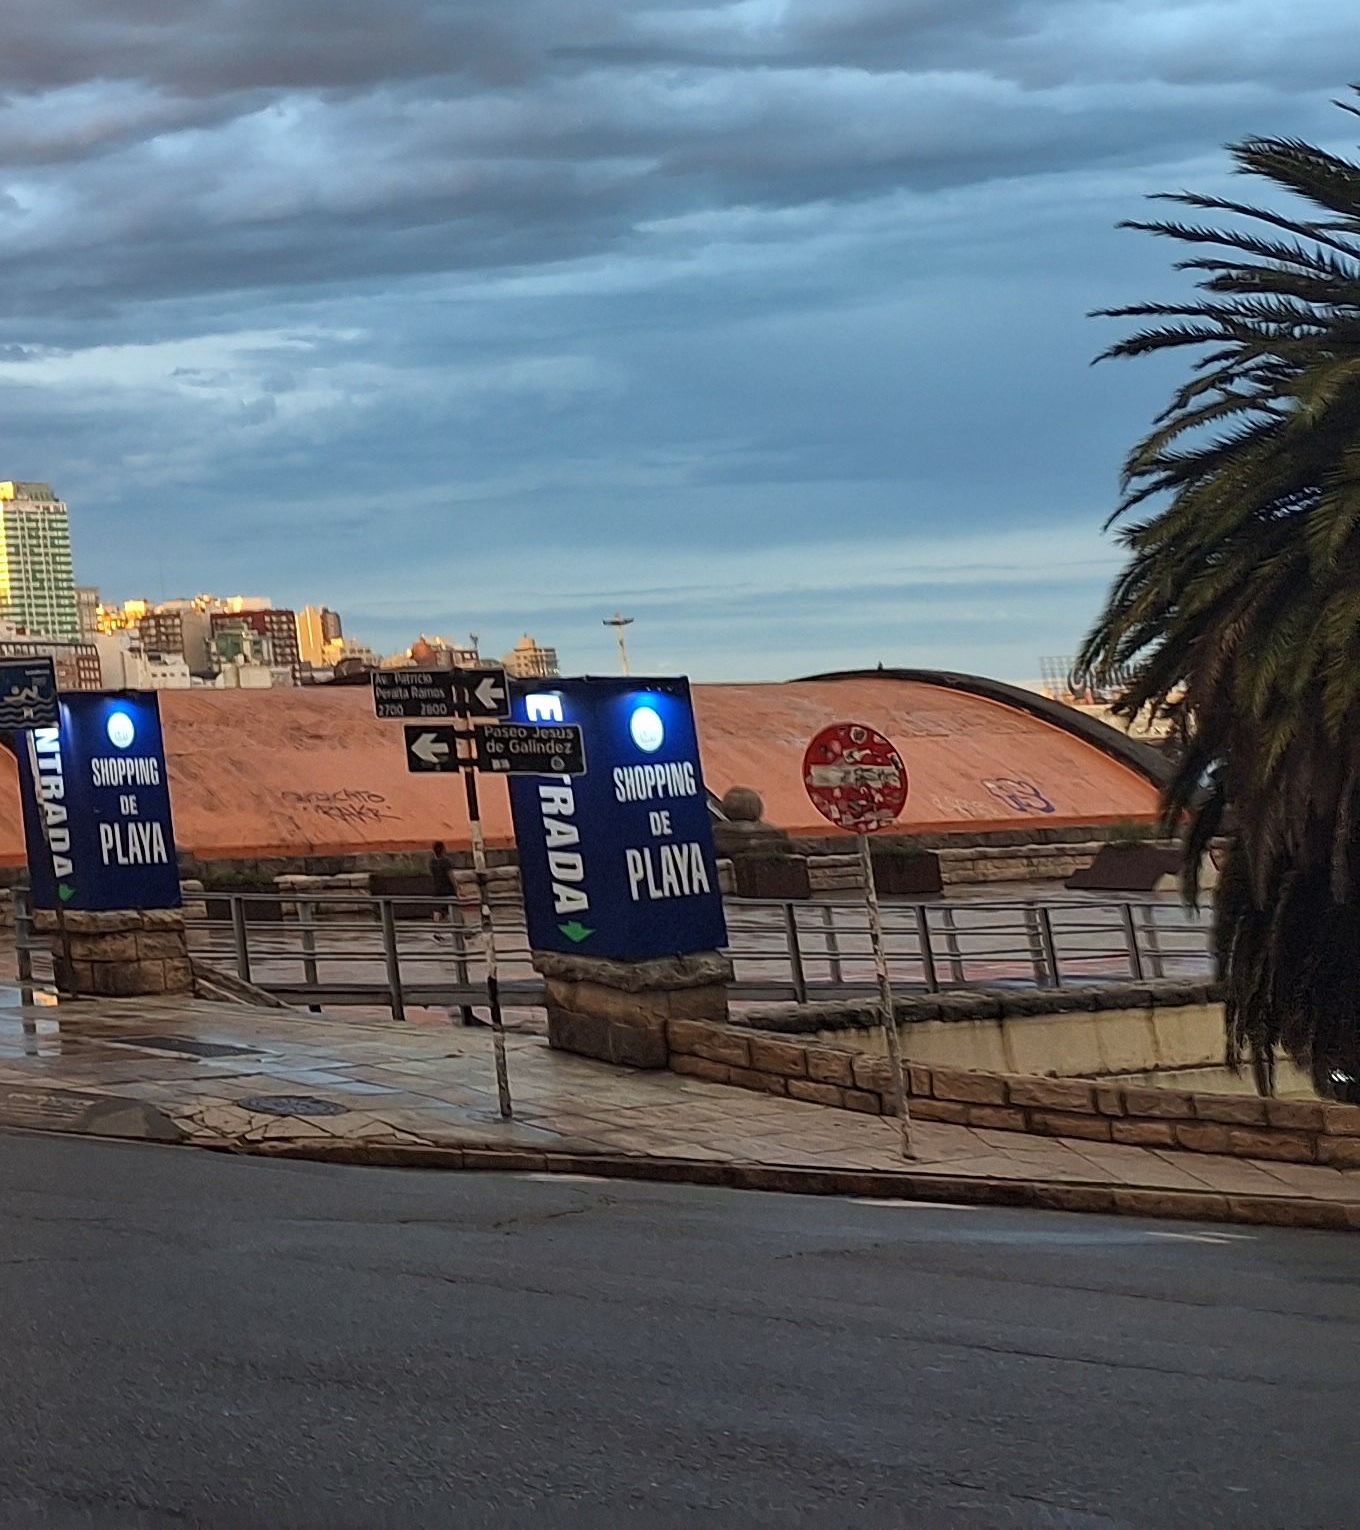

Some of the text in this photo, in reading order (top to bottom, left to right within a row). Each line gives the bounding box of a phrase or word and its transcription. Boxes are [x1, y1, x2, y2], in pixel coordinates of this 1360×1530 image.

[376, 686, 445, 700] Peralta Ramos
[484, 725, 527, 738] Paseo
[486, 738, 505, 753] de
[91, 757, 160, 787] SHOPPING
[613, 761, 697, 803] SHOPPING
[119, 794, 139, 816] DE
[649, 810, 673, 836] DE
[99, 821, 169, 866] PLAYA
[625, 842, 711, 901] PLAYA
